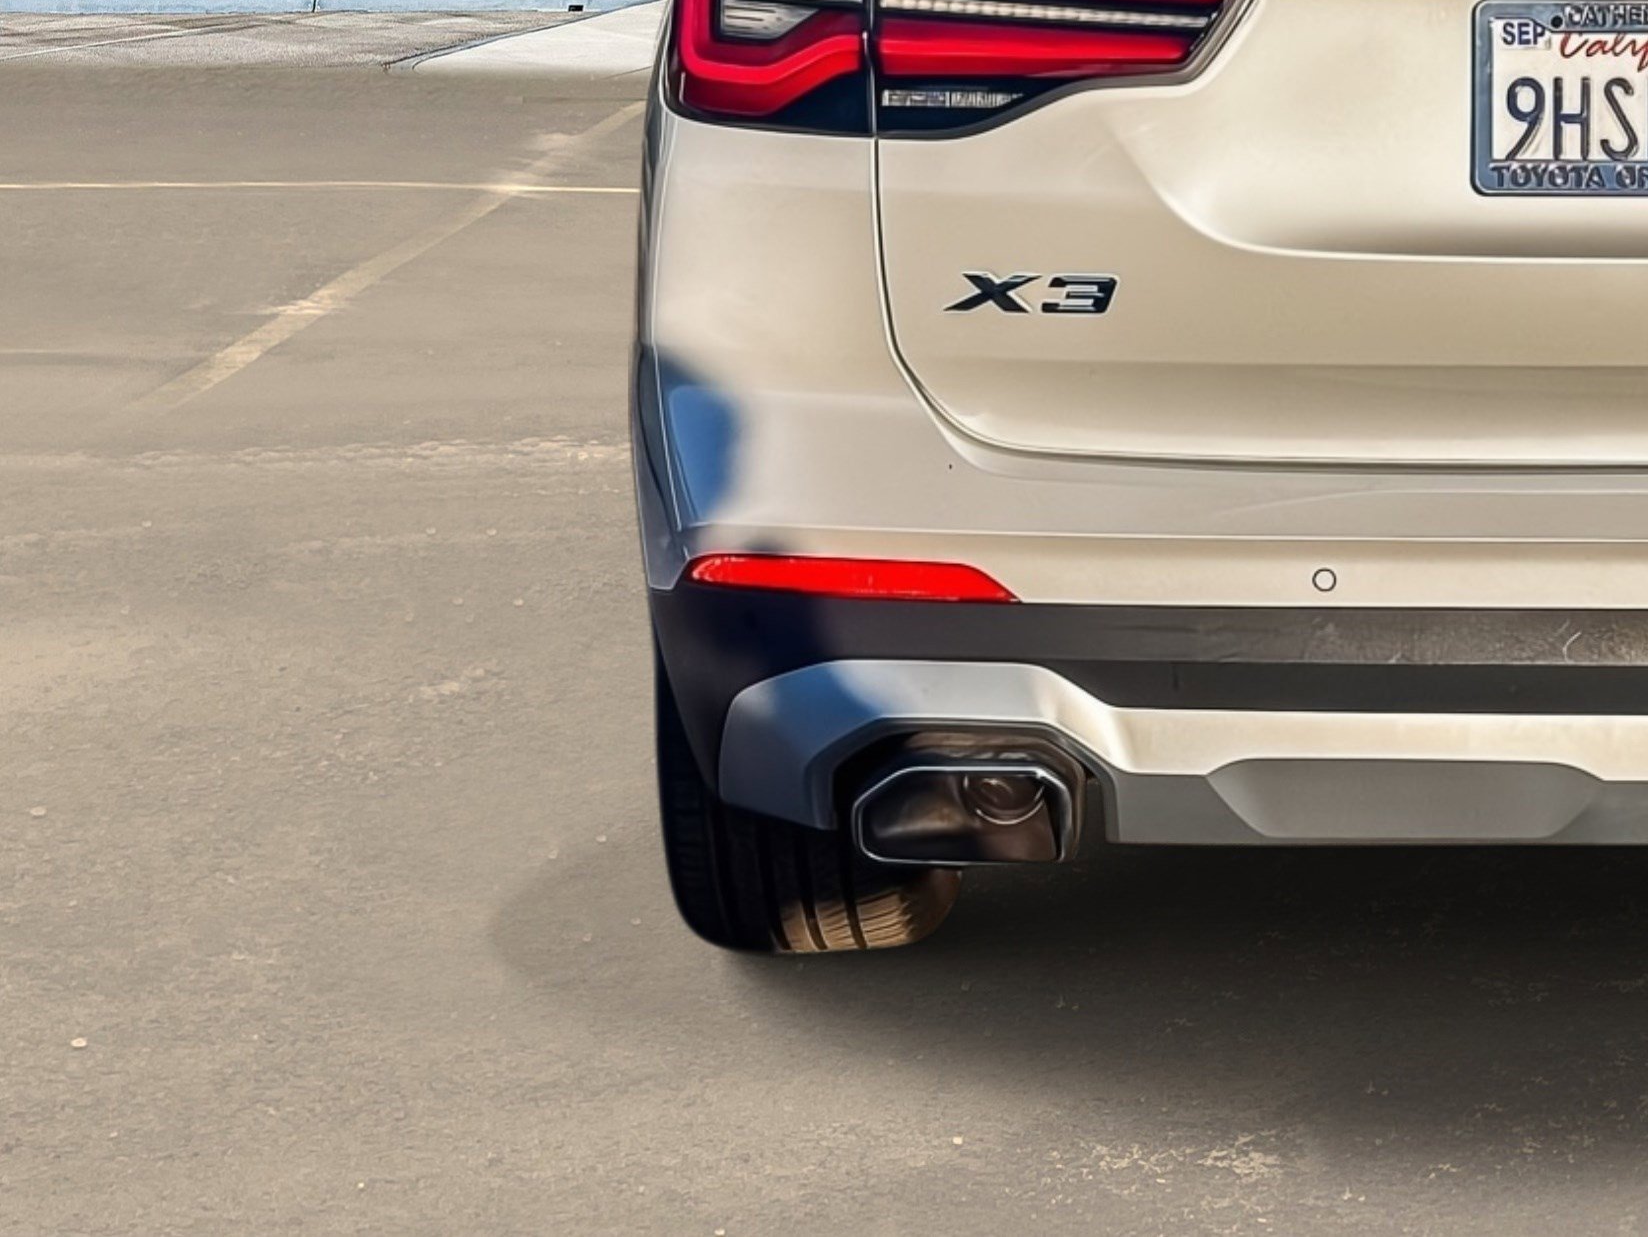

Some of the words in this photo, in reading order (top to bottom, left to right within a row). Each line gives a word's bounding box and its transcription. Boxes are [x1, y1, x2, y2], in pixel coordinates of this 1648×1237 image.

[1502, 22, 1547, 46] SEP
[1490, 164, 1605, 190] TOYOTA
[943, 272, 1118, 315] X3
